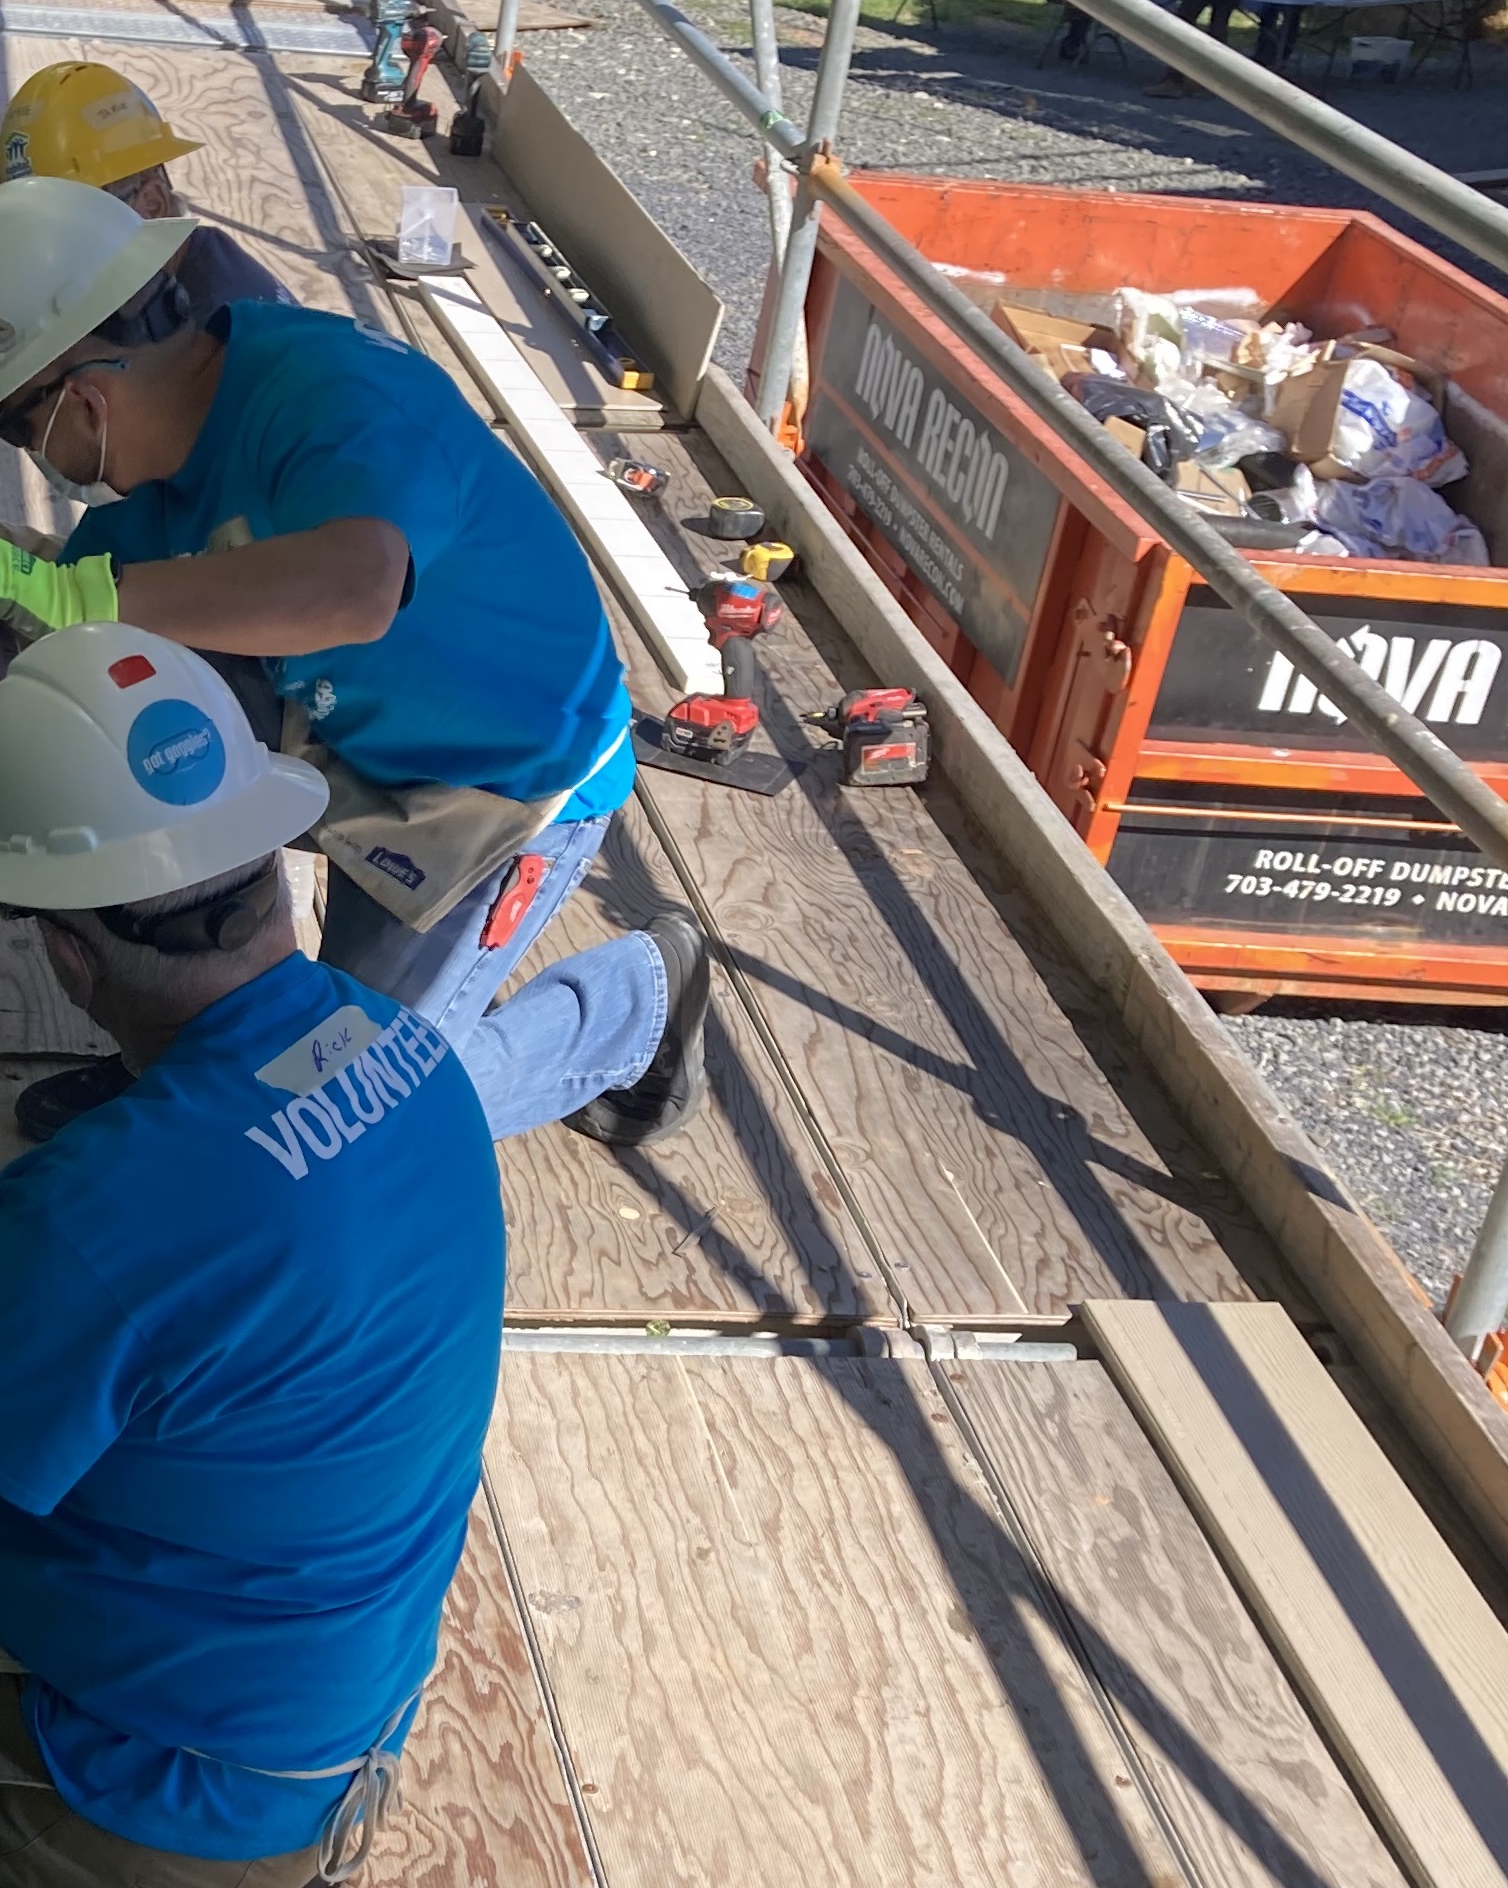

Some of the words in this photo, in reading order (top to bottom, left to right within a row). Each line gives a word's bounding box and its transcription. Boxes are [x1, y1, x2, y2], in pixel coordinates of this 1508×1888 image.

[855, 324, 925, 450] NOVA
[917, 387, 1009, 541] RECON
[1224, 874, 1402, 906] 703-479-2219
[1436, 891, 1508, 916] NOVA
[1255, 849, 1386, 879] ROLL-OFF
[244, 1005, 450, 1180] VOLUNTEE
